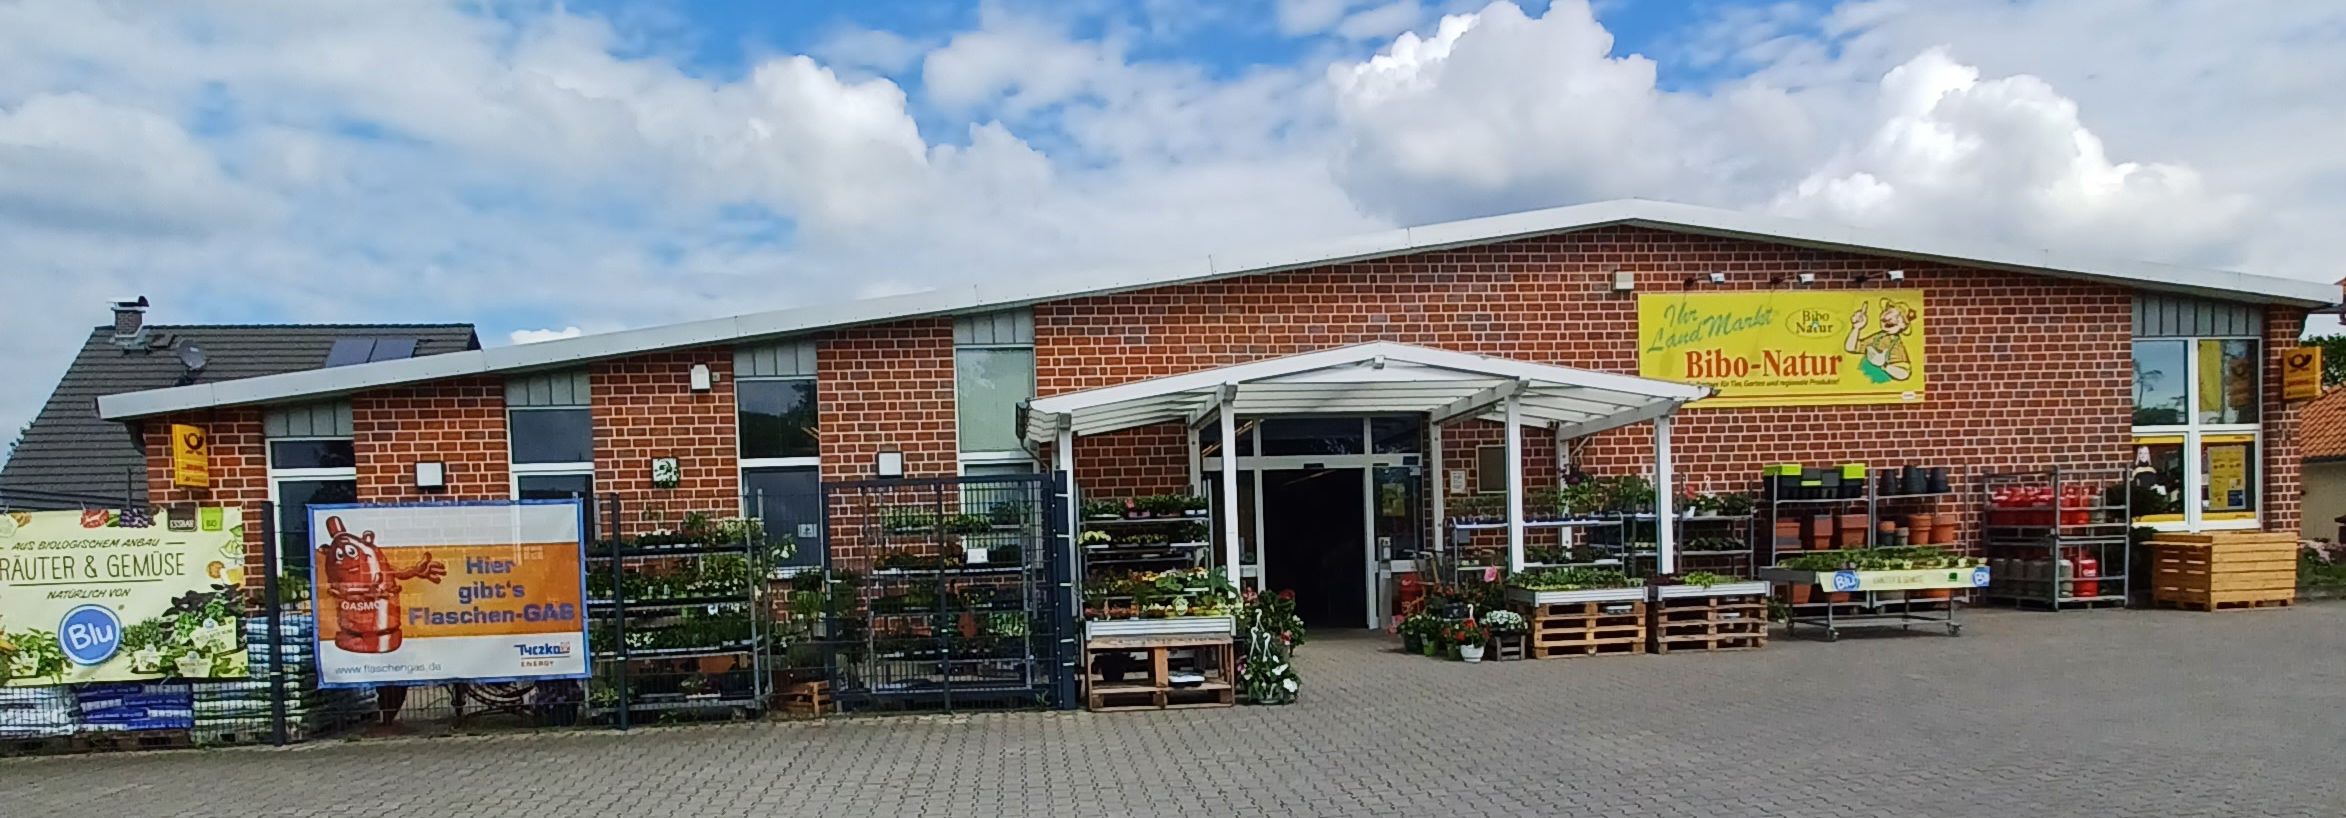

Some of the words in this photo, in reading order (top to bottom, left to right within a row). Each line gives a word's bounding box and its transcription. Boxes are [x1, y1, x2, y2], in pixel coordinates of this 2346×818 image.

[1664, 301, 1698, 327] Ihr
[1802, 309, 1830, 325] Bibo
[1646, 327, 1703, 354] Land
[1703, 304, 1773, 338] Markt
[1796, 321, 1834, 334] Natur
[1684, 348, 1843, 379] Bibo-Natur
[11, 541, 36, 551] AUS
[37, 538, 121, 551] BIOLOGISCHEM
[121, 537, 161, 548] ANBAU
[0, 555, 75, 581] RÄUTER
[84, 555, 98, 579] &
[106, 550, 186, 578] GEMÜSE
[466, 555, 517, 575] Hier
[47, 588, 107, 600] NATÜRLICH
[108, 588, 132, 598] VON
[458, 581, 526, 605] gibt's
[68, 622, 114, 651] Blu
[520, 660, 554, 668] ENERGY
